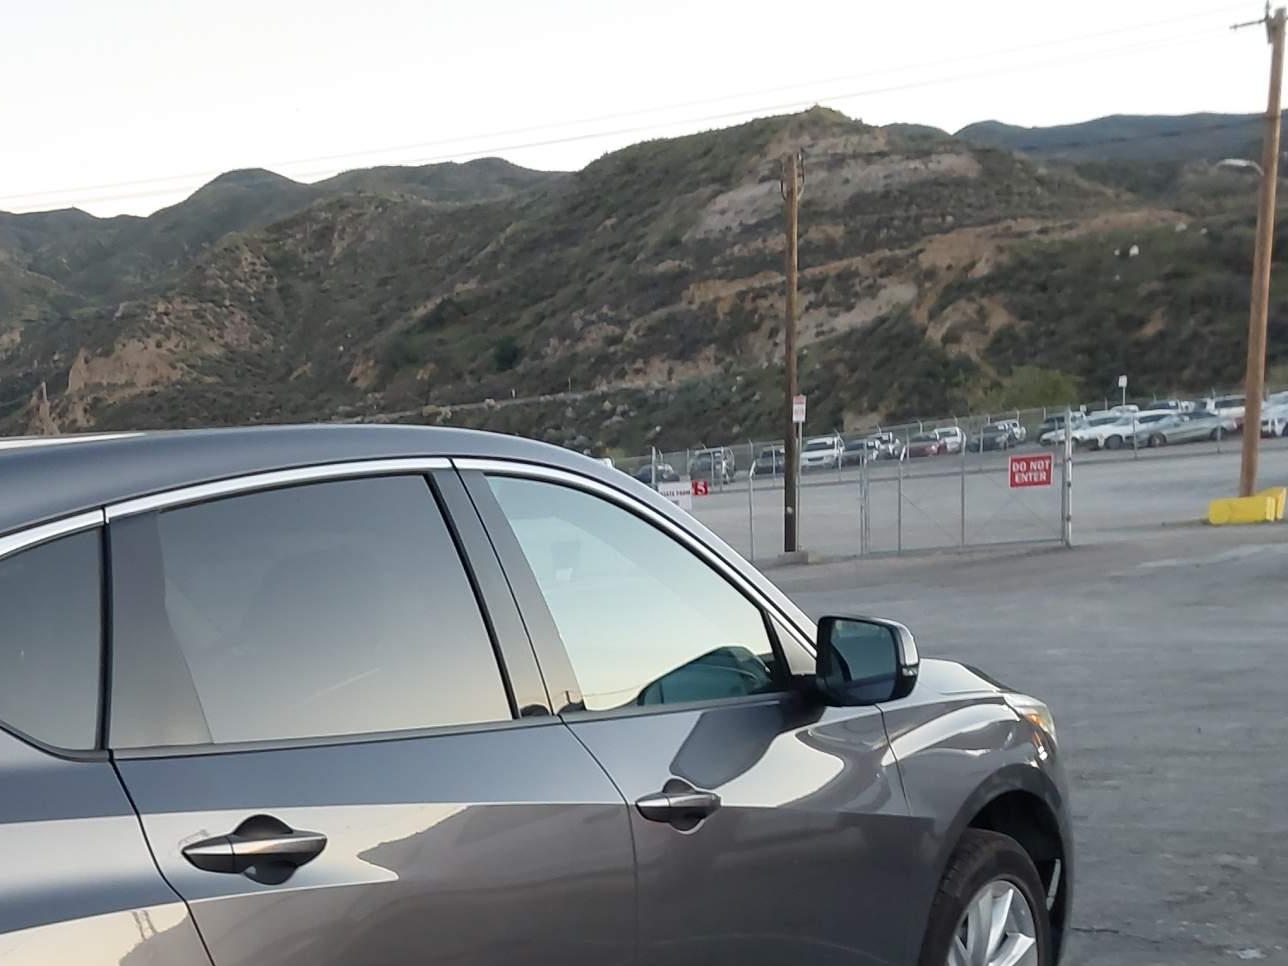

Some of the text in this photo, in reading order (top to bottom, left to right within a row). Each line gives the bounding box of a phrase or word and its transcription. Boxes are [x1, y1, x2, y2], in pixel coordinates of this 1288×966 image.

[1012, 460, 1049, 472] DO NOT
[1015, 471, 1047, 483] ENTER
